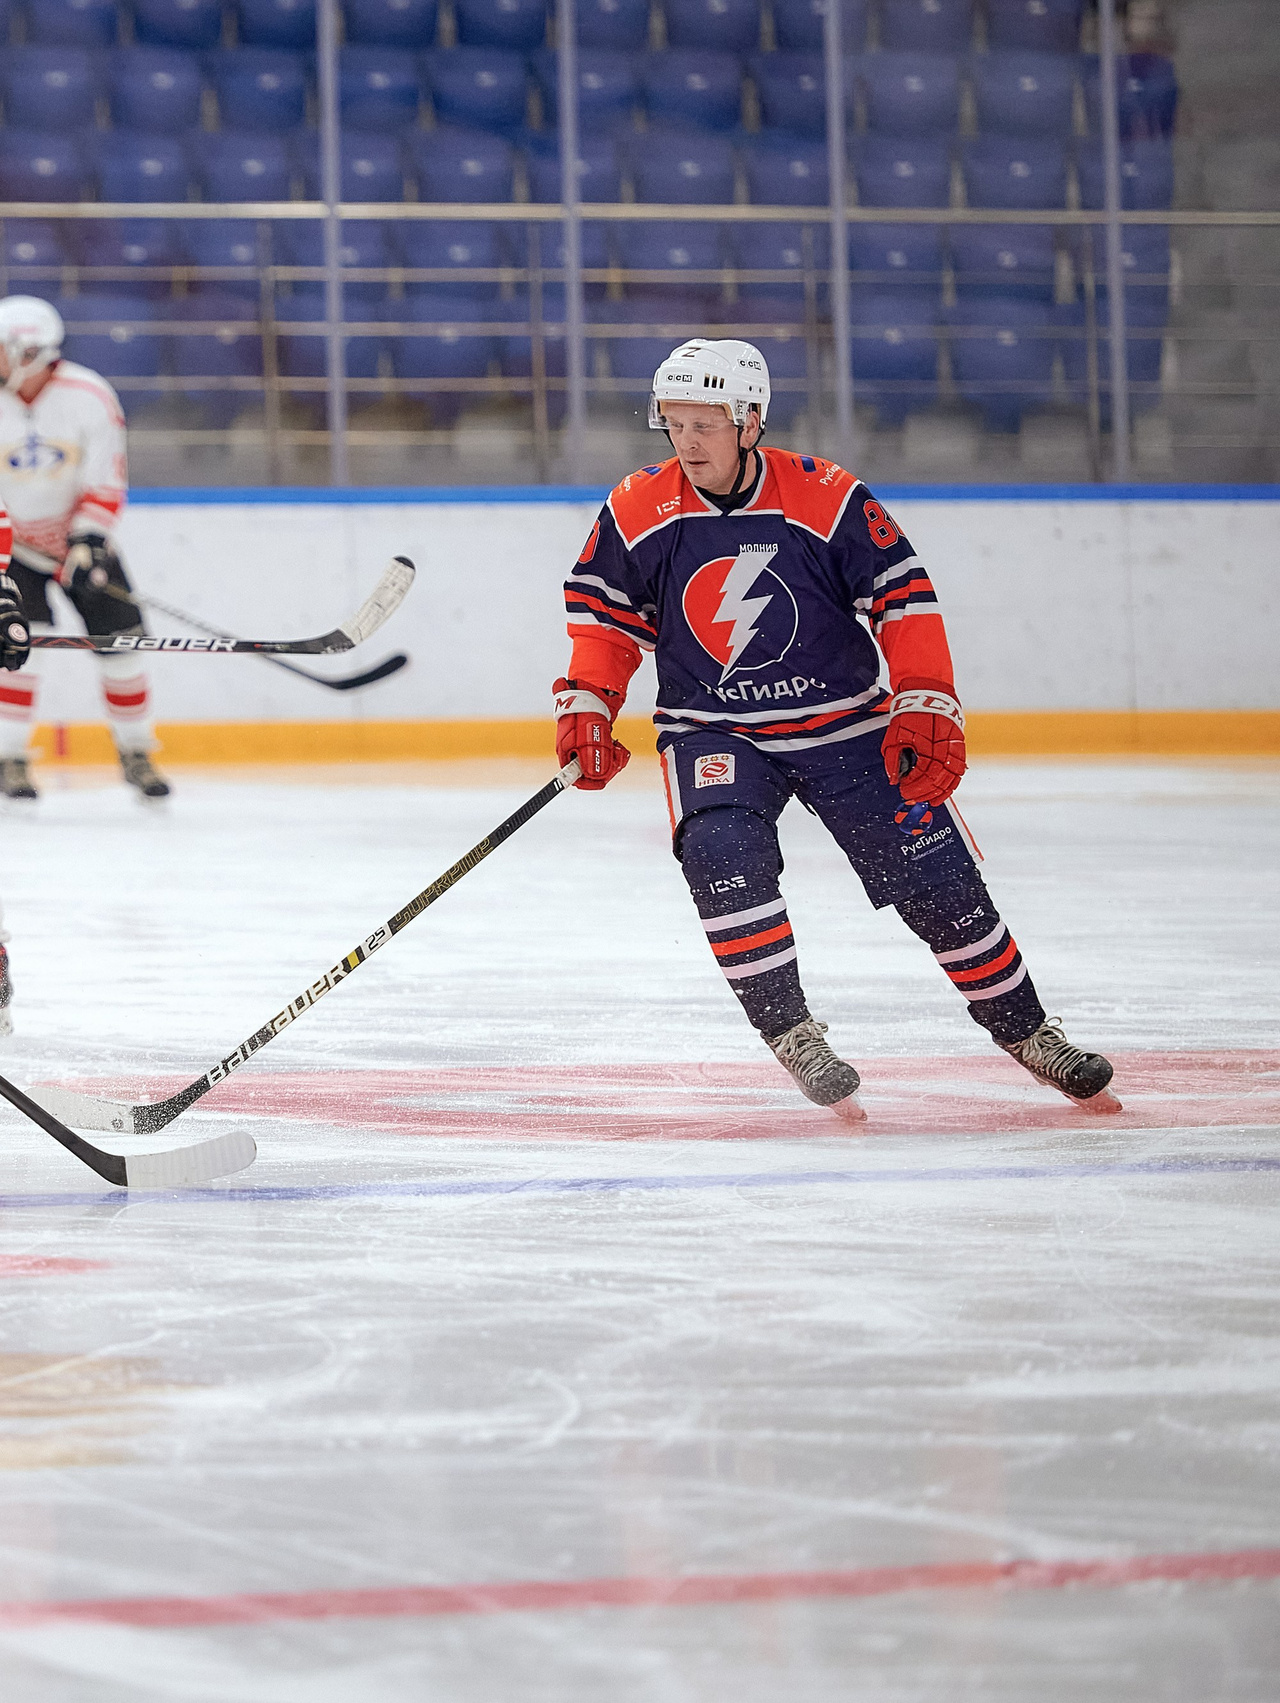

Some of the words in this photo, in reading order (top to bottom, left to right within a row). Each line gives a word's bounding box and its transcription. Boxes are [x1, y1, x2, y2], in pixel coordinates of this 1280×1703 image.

[739, 359, 761, 371] CCM
[667, 375, 693, 383] CCM
[739, 542, 779, 554] МОЛНИЯ
[893, 694, 964, 730] CCM
[698, 776, 730, 787] НПХЛ
[900, 826, 952, 856] РусГидро
[395, 836, 495, 931] SUPREME
